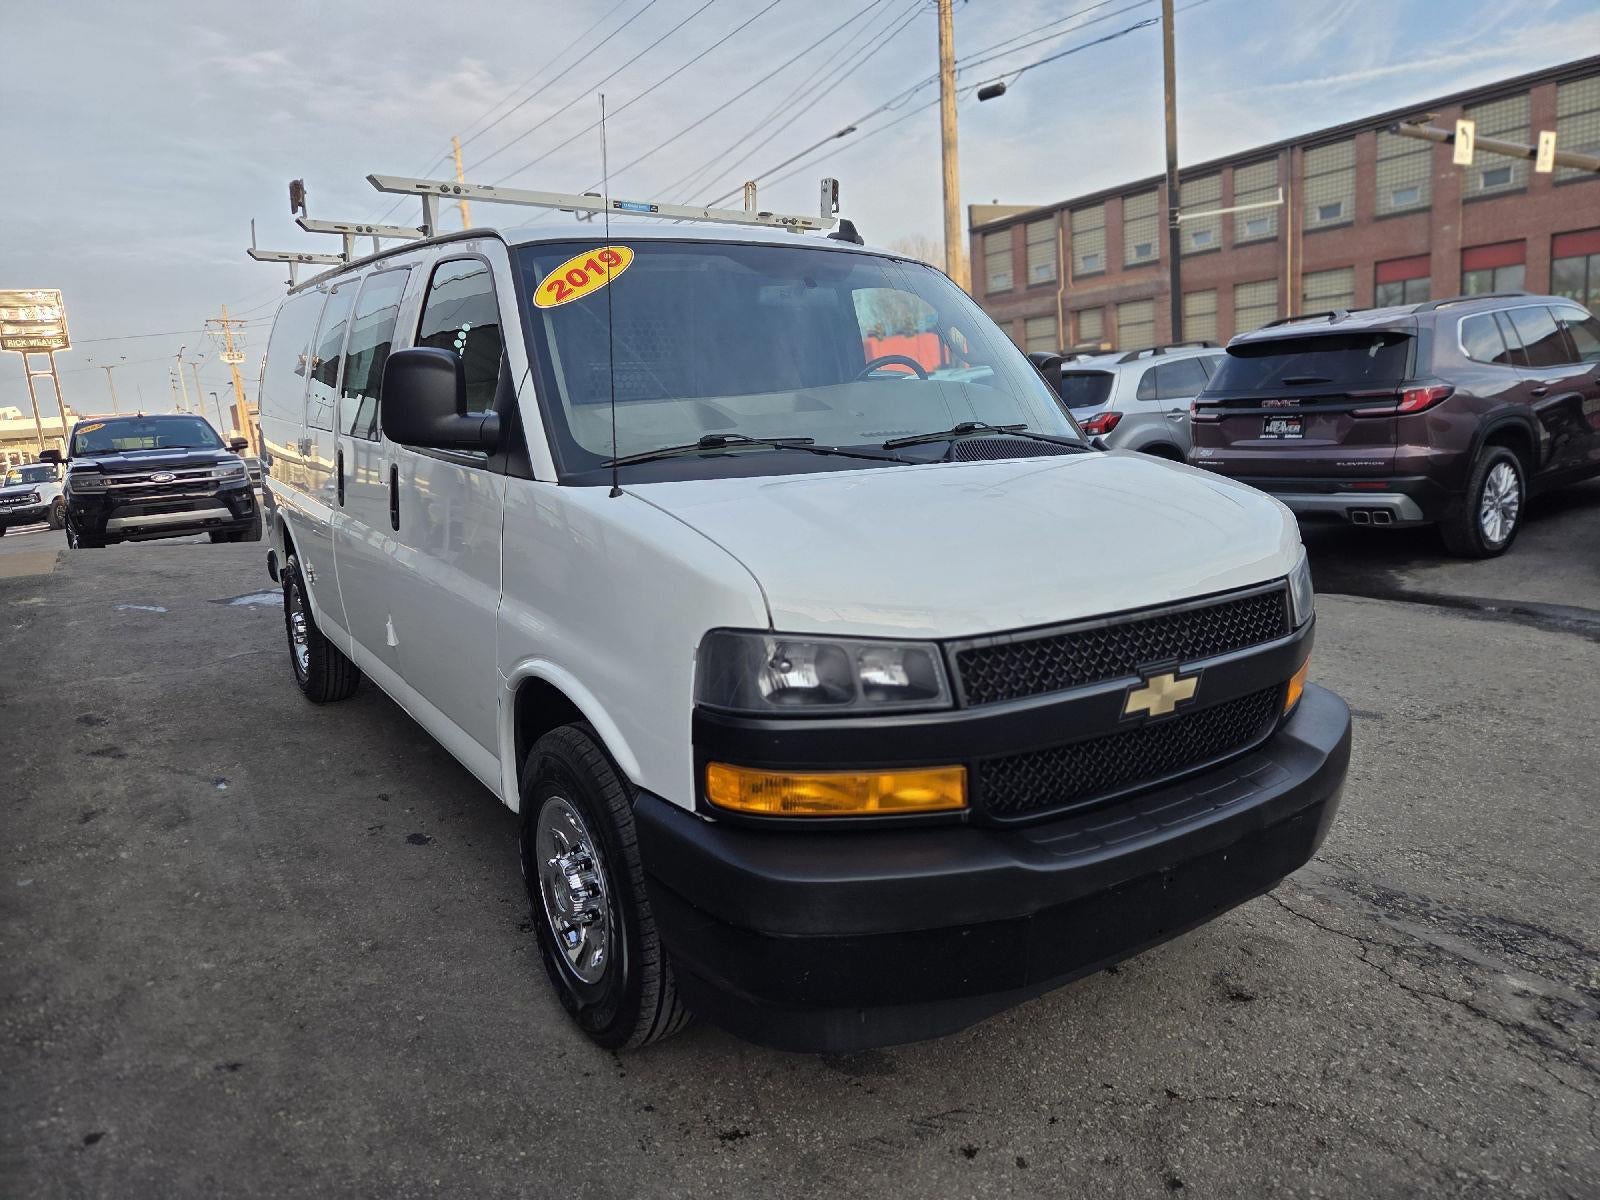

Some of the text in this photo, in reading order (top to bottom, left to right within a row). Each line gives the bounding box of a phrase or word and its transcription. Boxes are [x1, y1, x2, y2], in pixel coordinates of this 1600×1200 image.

[546, 249, 623, 302] 2019
[7, 338, 63, 347] RICK WEAVER
[1261, 399, 1300, 407] GMC
[1265, 424, 1301, 433] WEAVER
